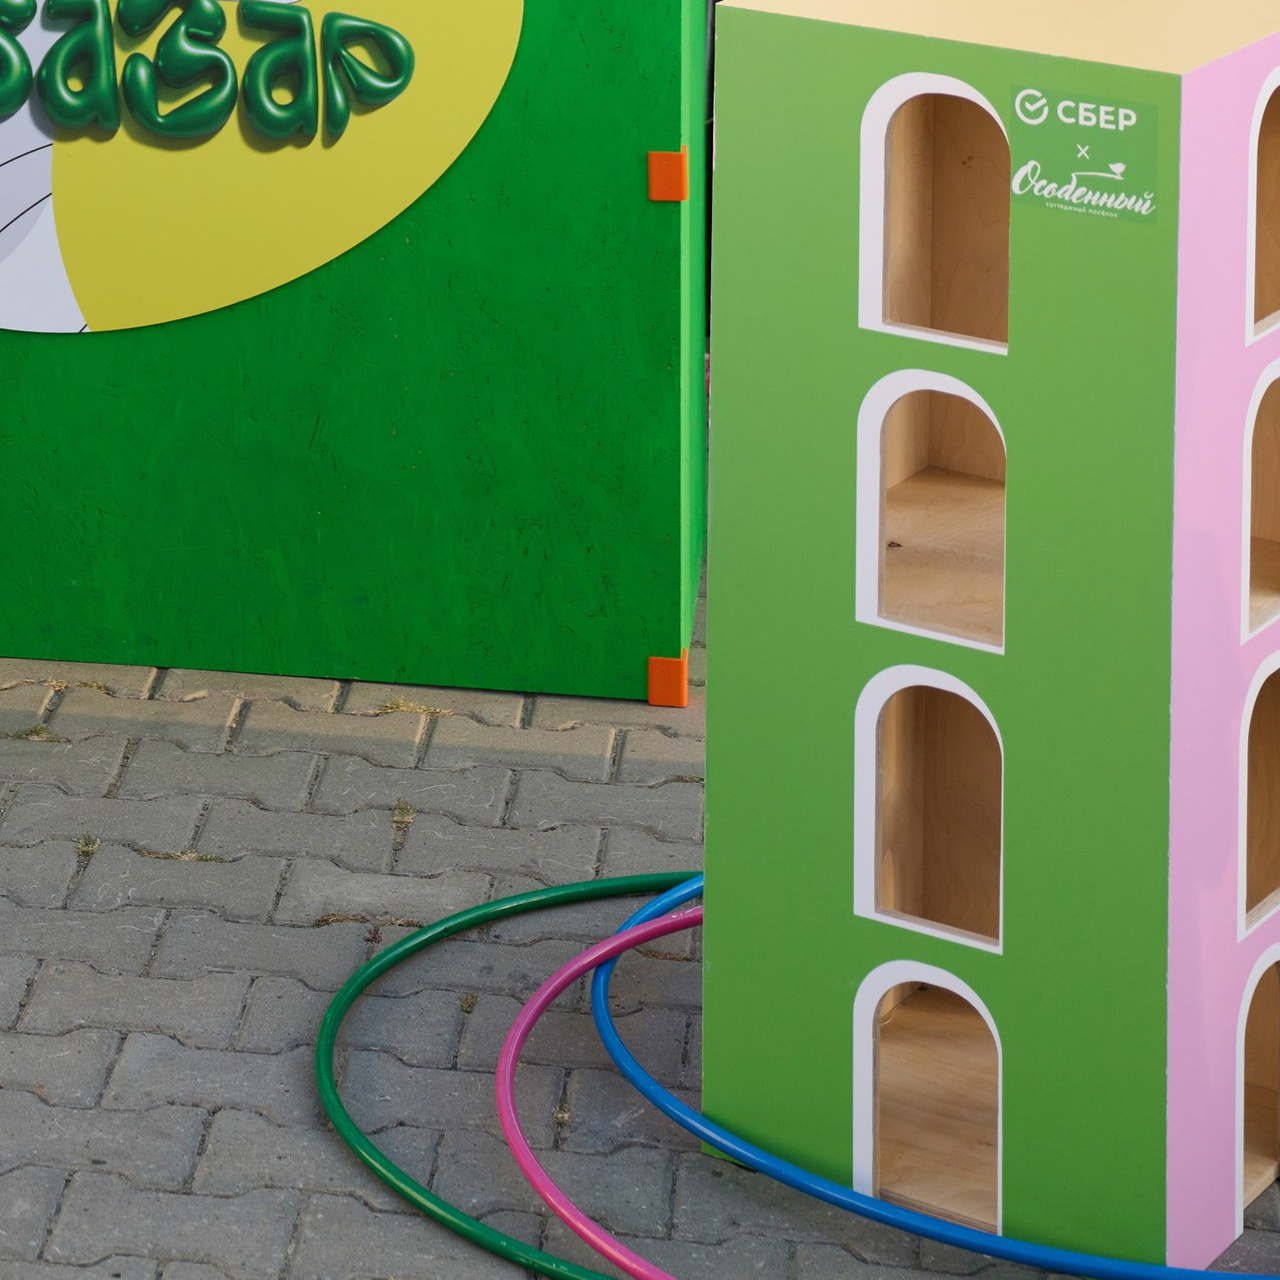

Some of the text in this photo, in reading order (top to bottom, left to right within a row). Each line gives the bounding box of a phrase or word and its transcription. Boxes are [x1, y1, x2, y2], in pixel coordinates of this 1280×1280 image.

[1056, 99, 1138, 132] СБЕР
[1011, 160, 1157, 216] Особенный
[1045, 201, 1087, 214] коттеджный
